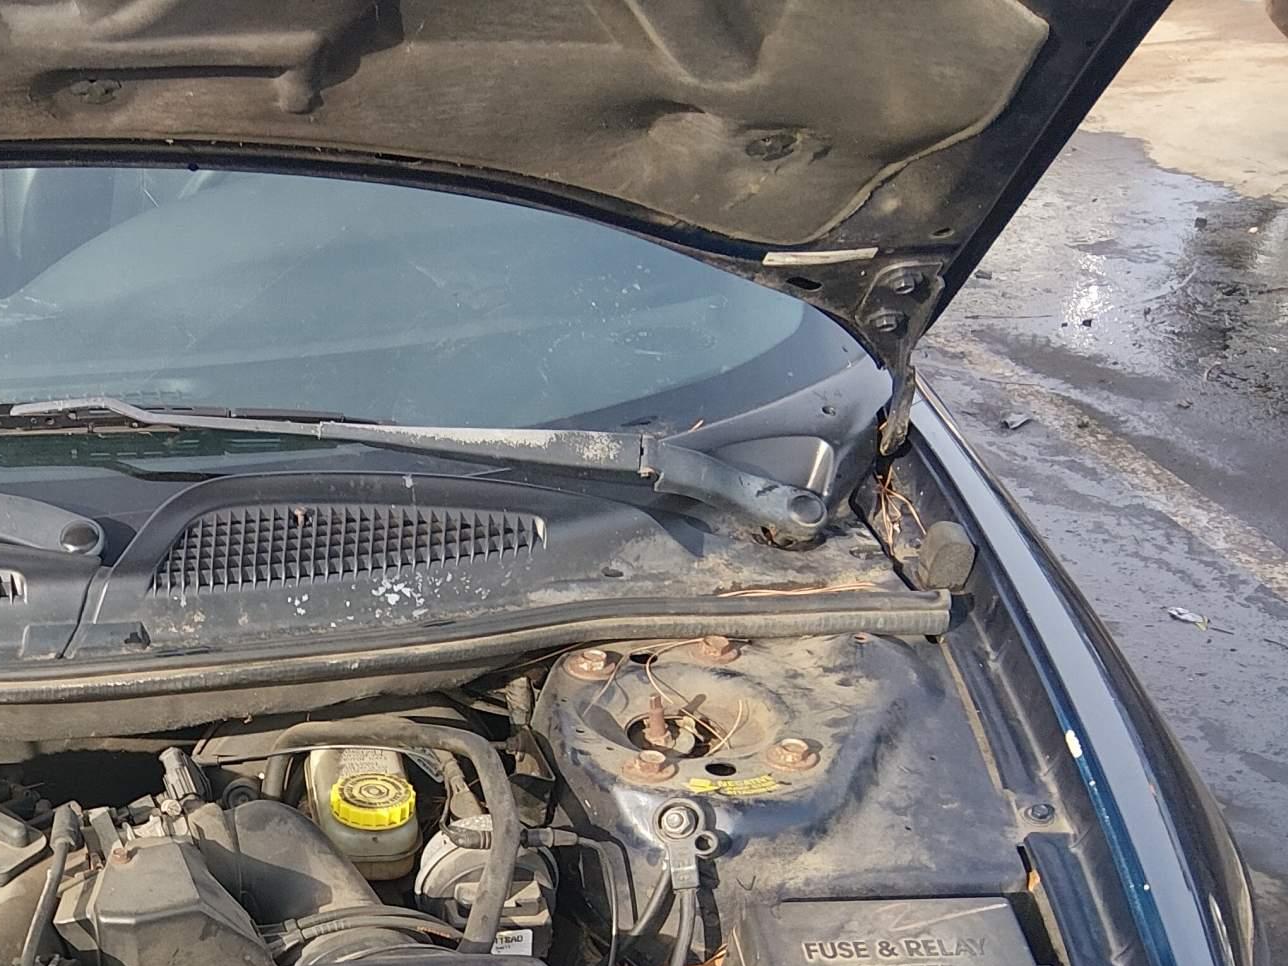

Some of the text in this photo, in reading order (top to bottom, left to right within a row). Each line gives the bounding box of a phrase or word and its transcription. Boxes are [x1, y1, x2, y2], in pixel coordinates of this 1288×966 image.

[804, 936, 988, 961] FUSE & RELAY
